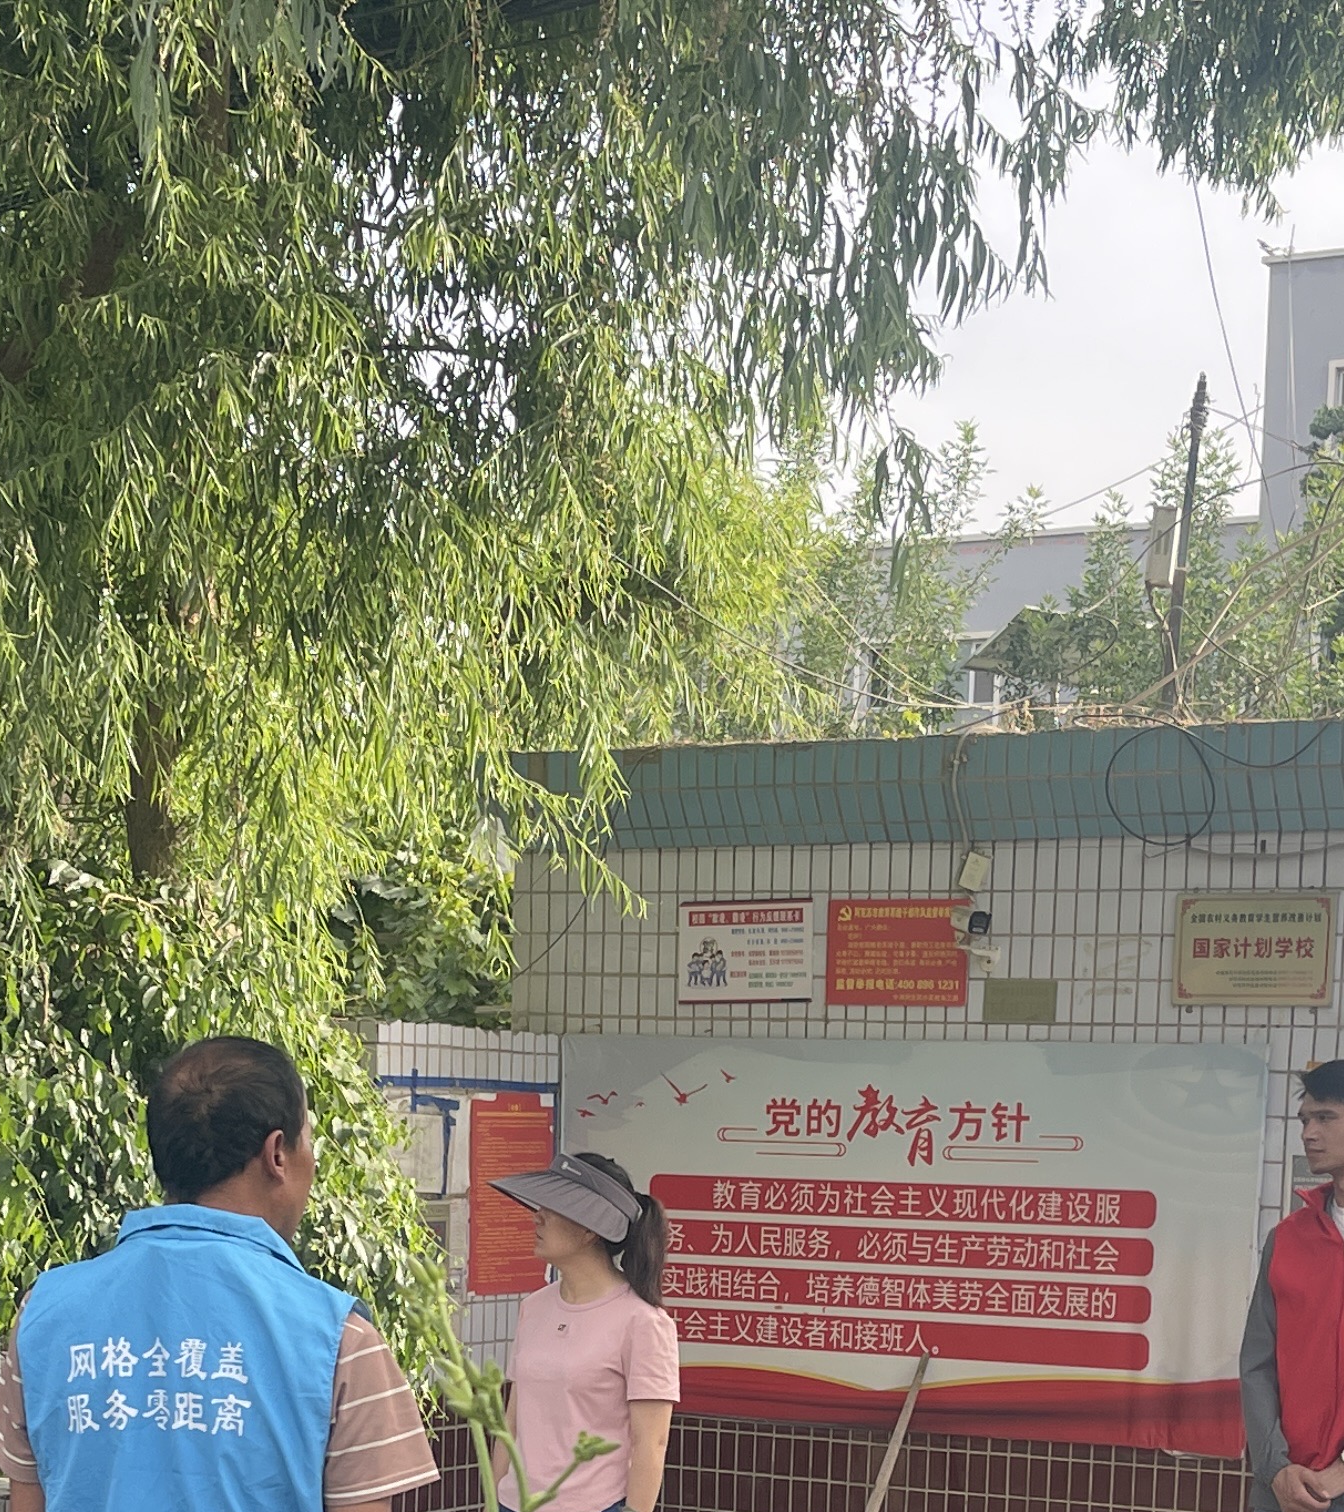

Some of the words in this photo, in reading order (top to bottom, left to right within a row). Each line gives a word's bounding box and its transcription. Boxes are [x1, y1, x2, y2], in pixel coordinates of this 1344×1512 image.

[1192, 936, 1315, 959] 国家计划学校
[765, 1083, 1031, 1166] 党的教育方针
[712, 1179, 1122, 1225] 教育必须为社会主义现代化建设服
[67, 1336, 250, 1384] 网格全覆盖
[67, 1389, 252, 1437] 服务零距离
